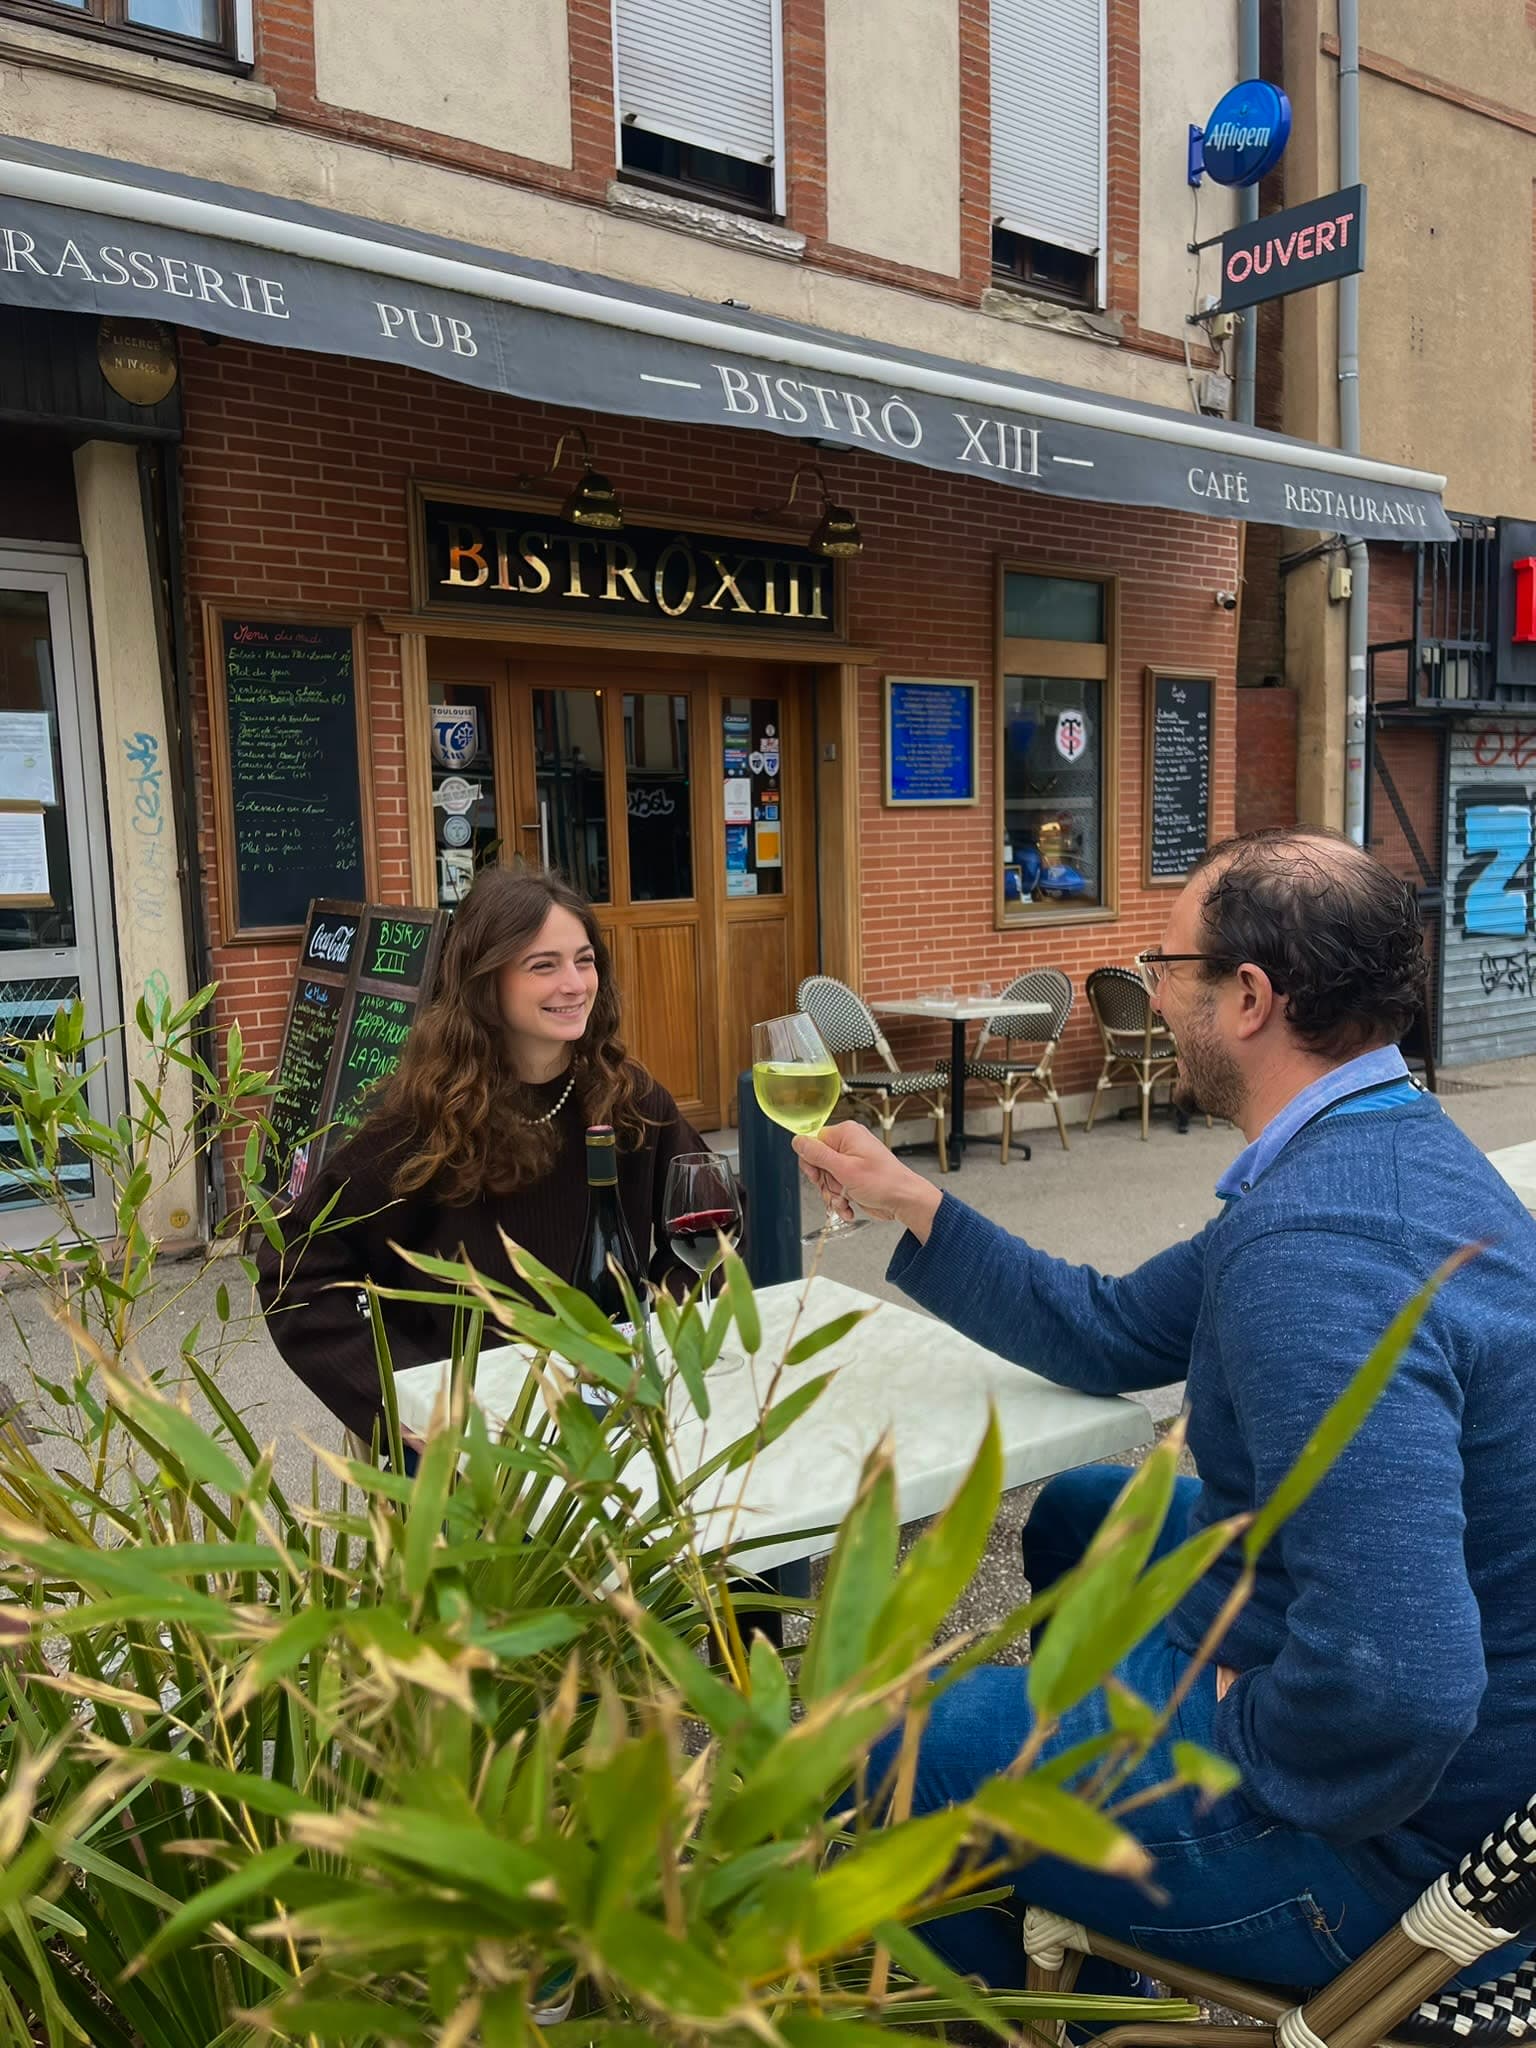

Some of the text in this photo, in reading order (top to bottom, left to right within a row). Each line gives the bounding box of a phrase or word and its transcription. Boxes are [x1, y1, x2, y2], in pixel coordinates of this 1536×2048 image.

[1206, 122, 1271, 151] Affligem
[1226, 213, 1354, 283] OUVERT
[0, 228, 479, 358] RASSERIE PUB
[710, 364, 1043, 477] BISTRÔ XIII
[1188, 468, 1426, 528] CAFÉ RESTAURANT
[233, 623, 269, 644] Menu
[228, 663, 249, 677] Plat
[252, 667, 267, 677] du
[271, 667, 291, 682] jour
[432, 707, 473, 716] TOULOUSE
[441, 747, 466, 760] XIII
[371, 948, 410, 975] XIII
[348, 1042, 368, 1069] LA
[367, 1047, 400, 1076] PINTE
